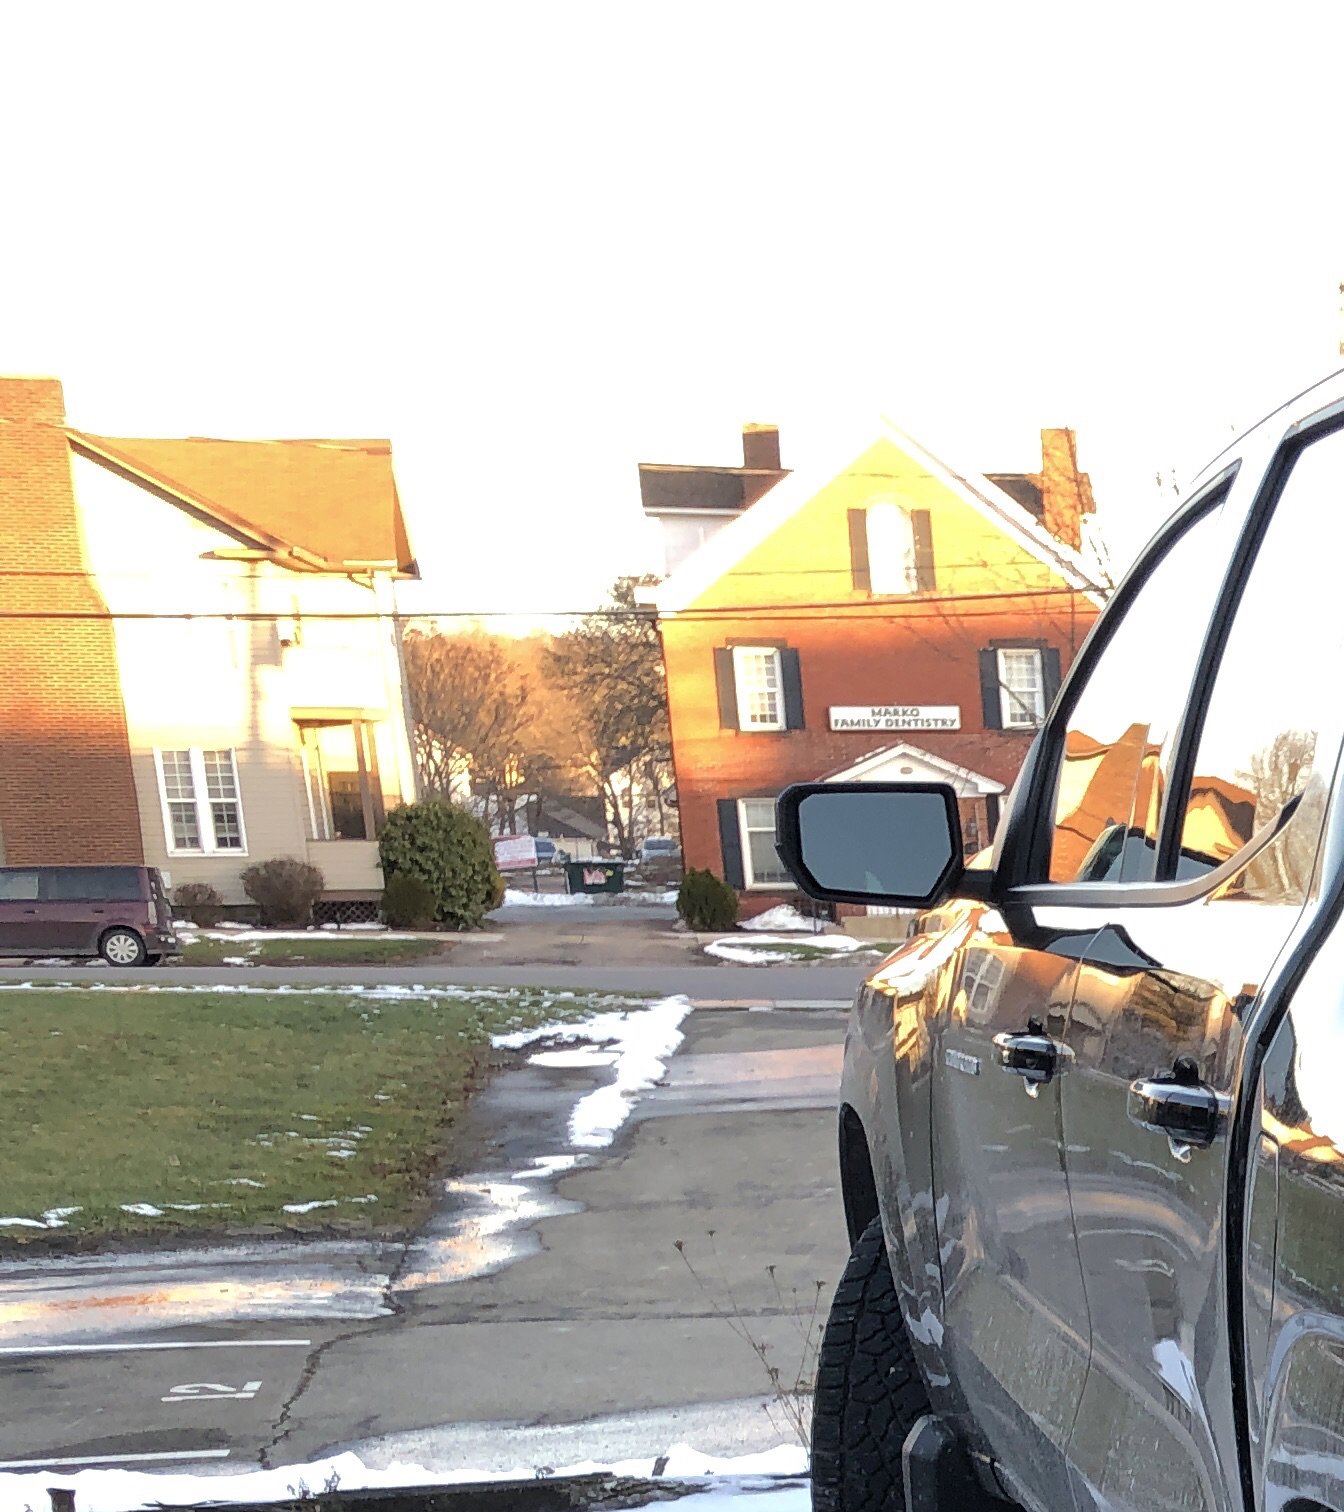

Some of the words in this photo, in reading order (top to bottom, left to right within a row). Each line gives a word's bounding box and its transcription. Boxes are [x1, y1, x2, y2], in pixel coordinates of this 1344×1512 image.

[871, 708, 920, 717] MARKO
[834, 718, 881, 727] FAMILY
[885, 718, 956, 727] DENTISTRY
